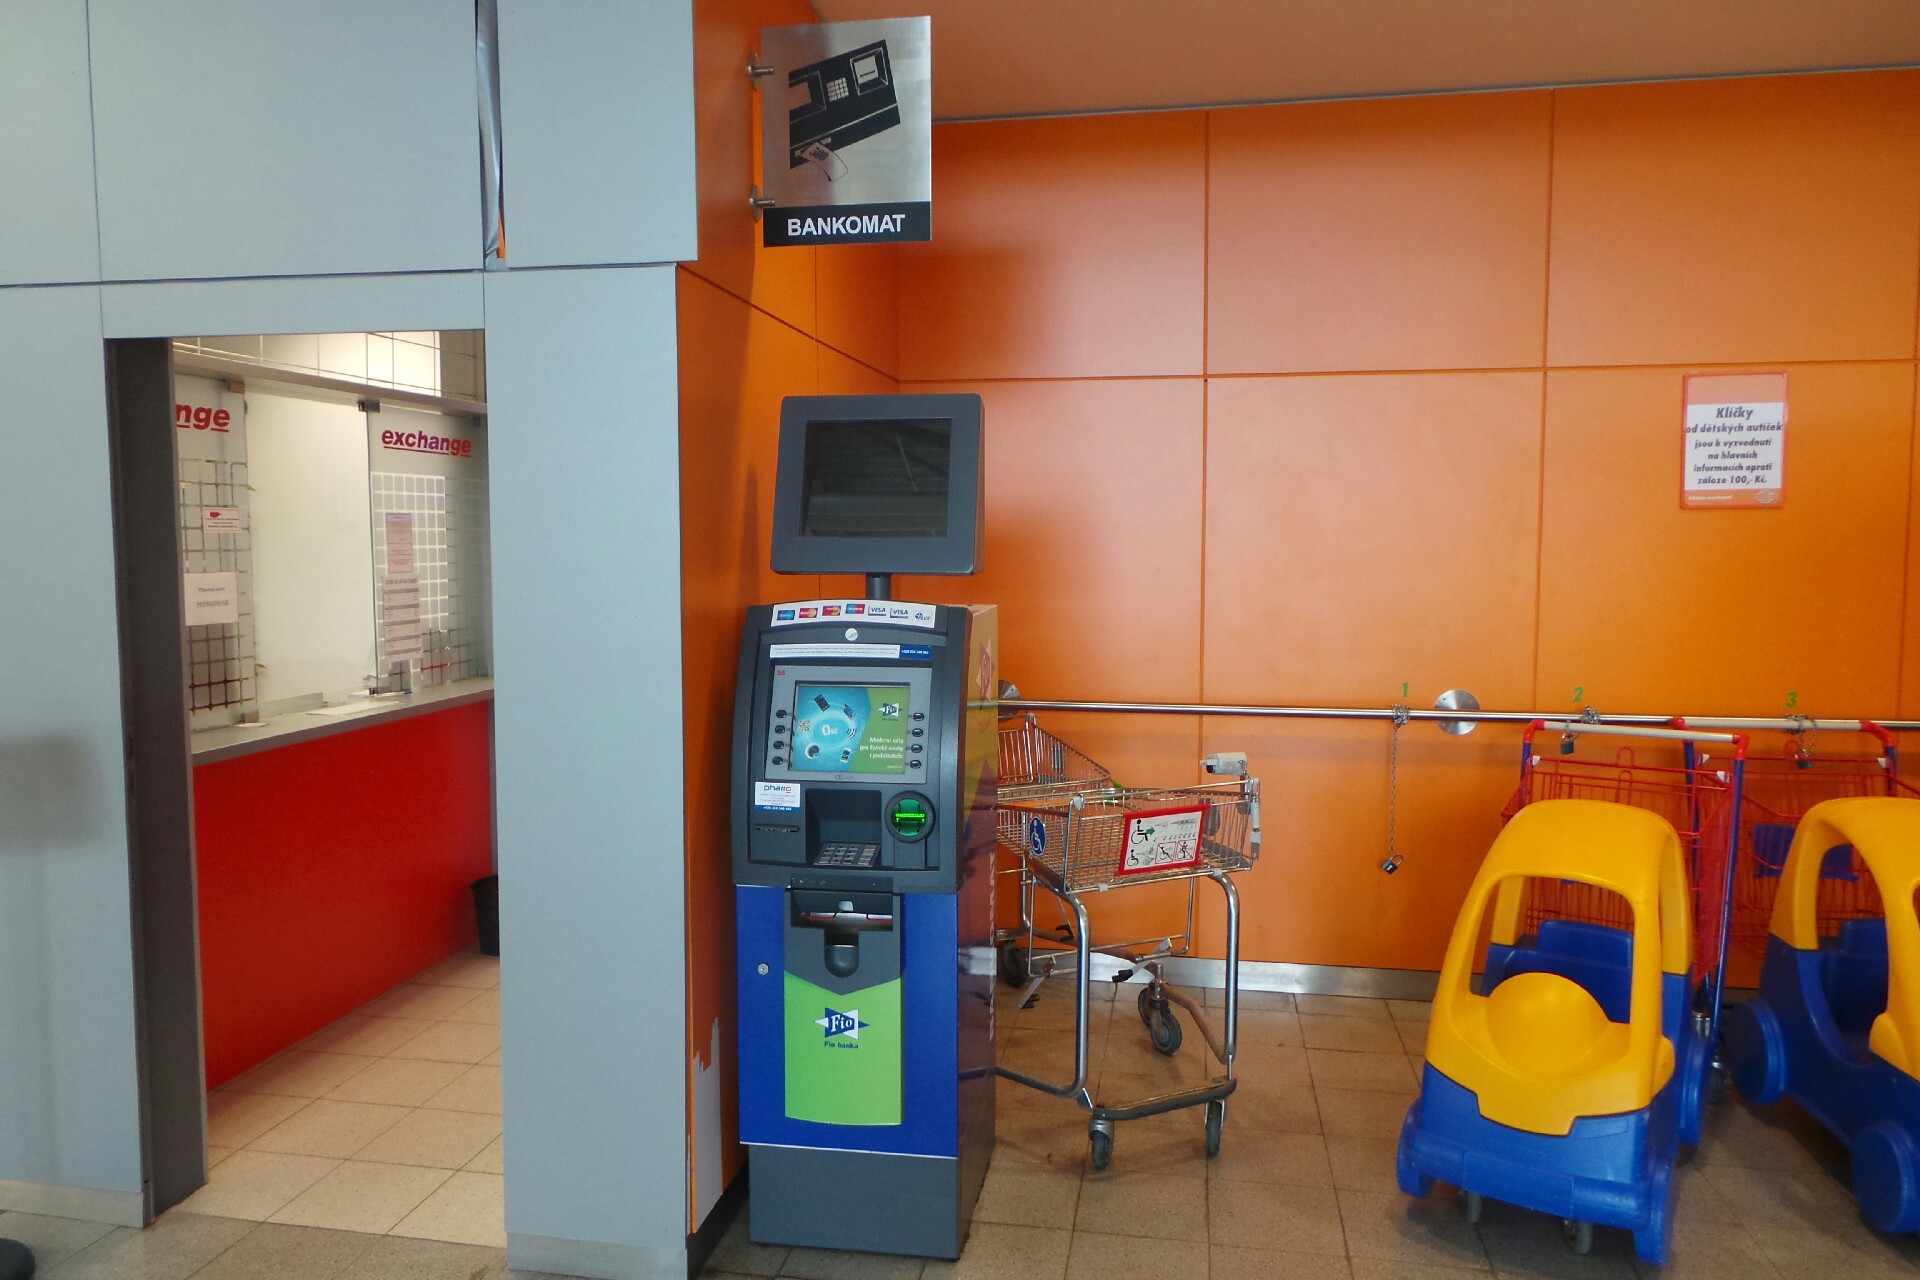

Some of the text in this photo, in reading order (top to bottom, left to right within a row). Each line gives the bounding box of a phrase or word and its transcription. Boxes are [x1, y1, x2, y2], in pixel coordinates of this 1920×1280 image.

[787, 213, 906, 236] BANKOMAT
[1686, 424, 1699, 433] od
[1700, 423, 1744, 434] dětských
[381, 429, 471, 456] exchange
[1694, 439, 1713, 449] jsou
[1715, 439, 1721, 447] k
[1708, 452, 1719, 460] na
[1402, 682, 1409, 698] 1
[1572, 686, 1584, 702] 2
[1785, 691, 1798, 708] 3
[830, 1014, 853, 1033] Fio
